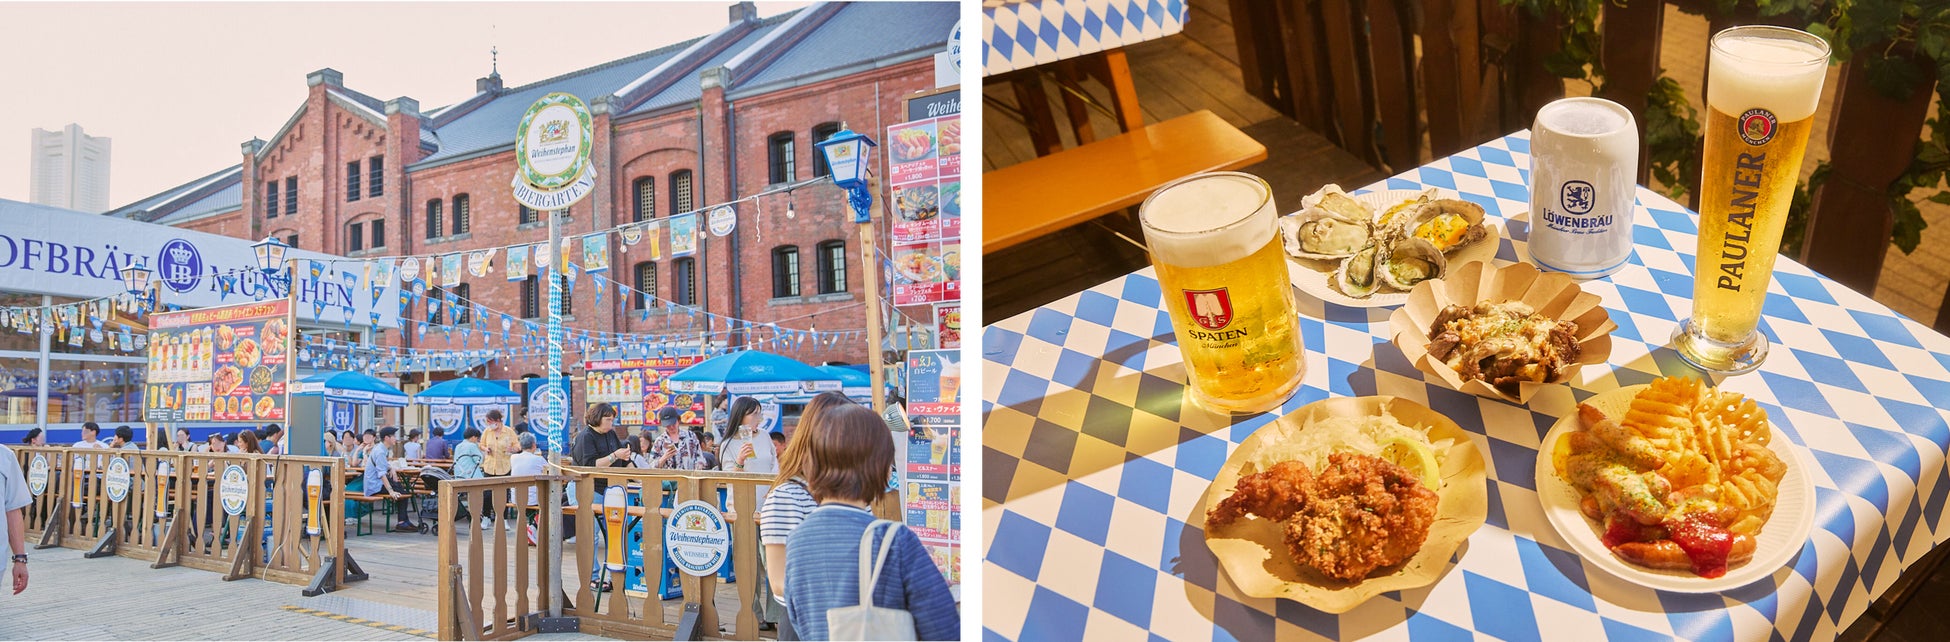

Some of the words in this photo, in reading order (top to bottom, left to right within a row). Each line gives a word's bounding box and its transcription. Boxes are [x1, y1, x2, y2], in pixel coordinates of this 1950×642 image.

[1741, 110, 1776, 124] PAULANER
[531, 144, 576, 159] Weihenstephan
[517, 180, 590, 208] BIERGARTEN
[1543, 208, 1613, 228] LÖWENBRÄU
[1717, 152, 1766, 292] PAULANER
[1188, 327, 1248, 341] SPATEN
[670, 531, 725, 545] Weihenstephaner
